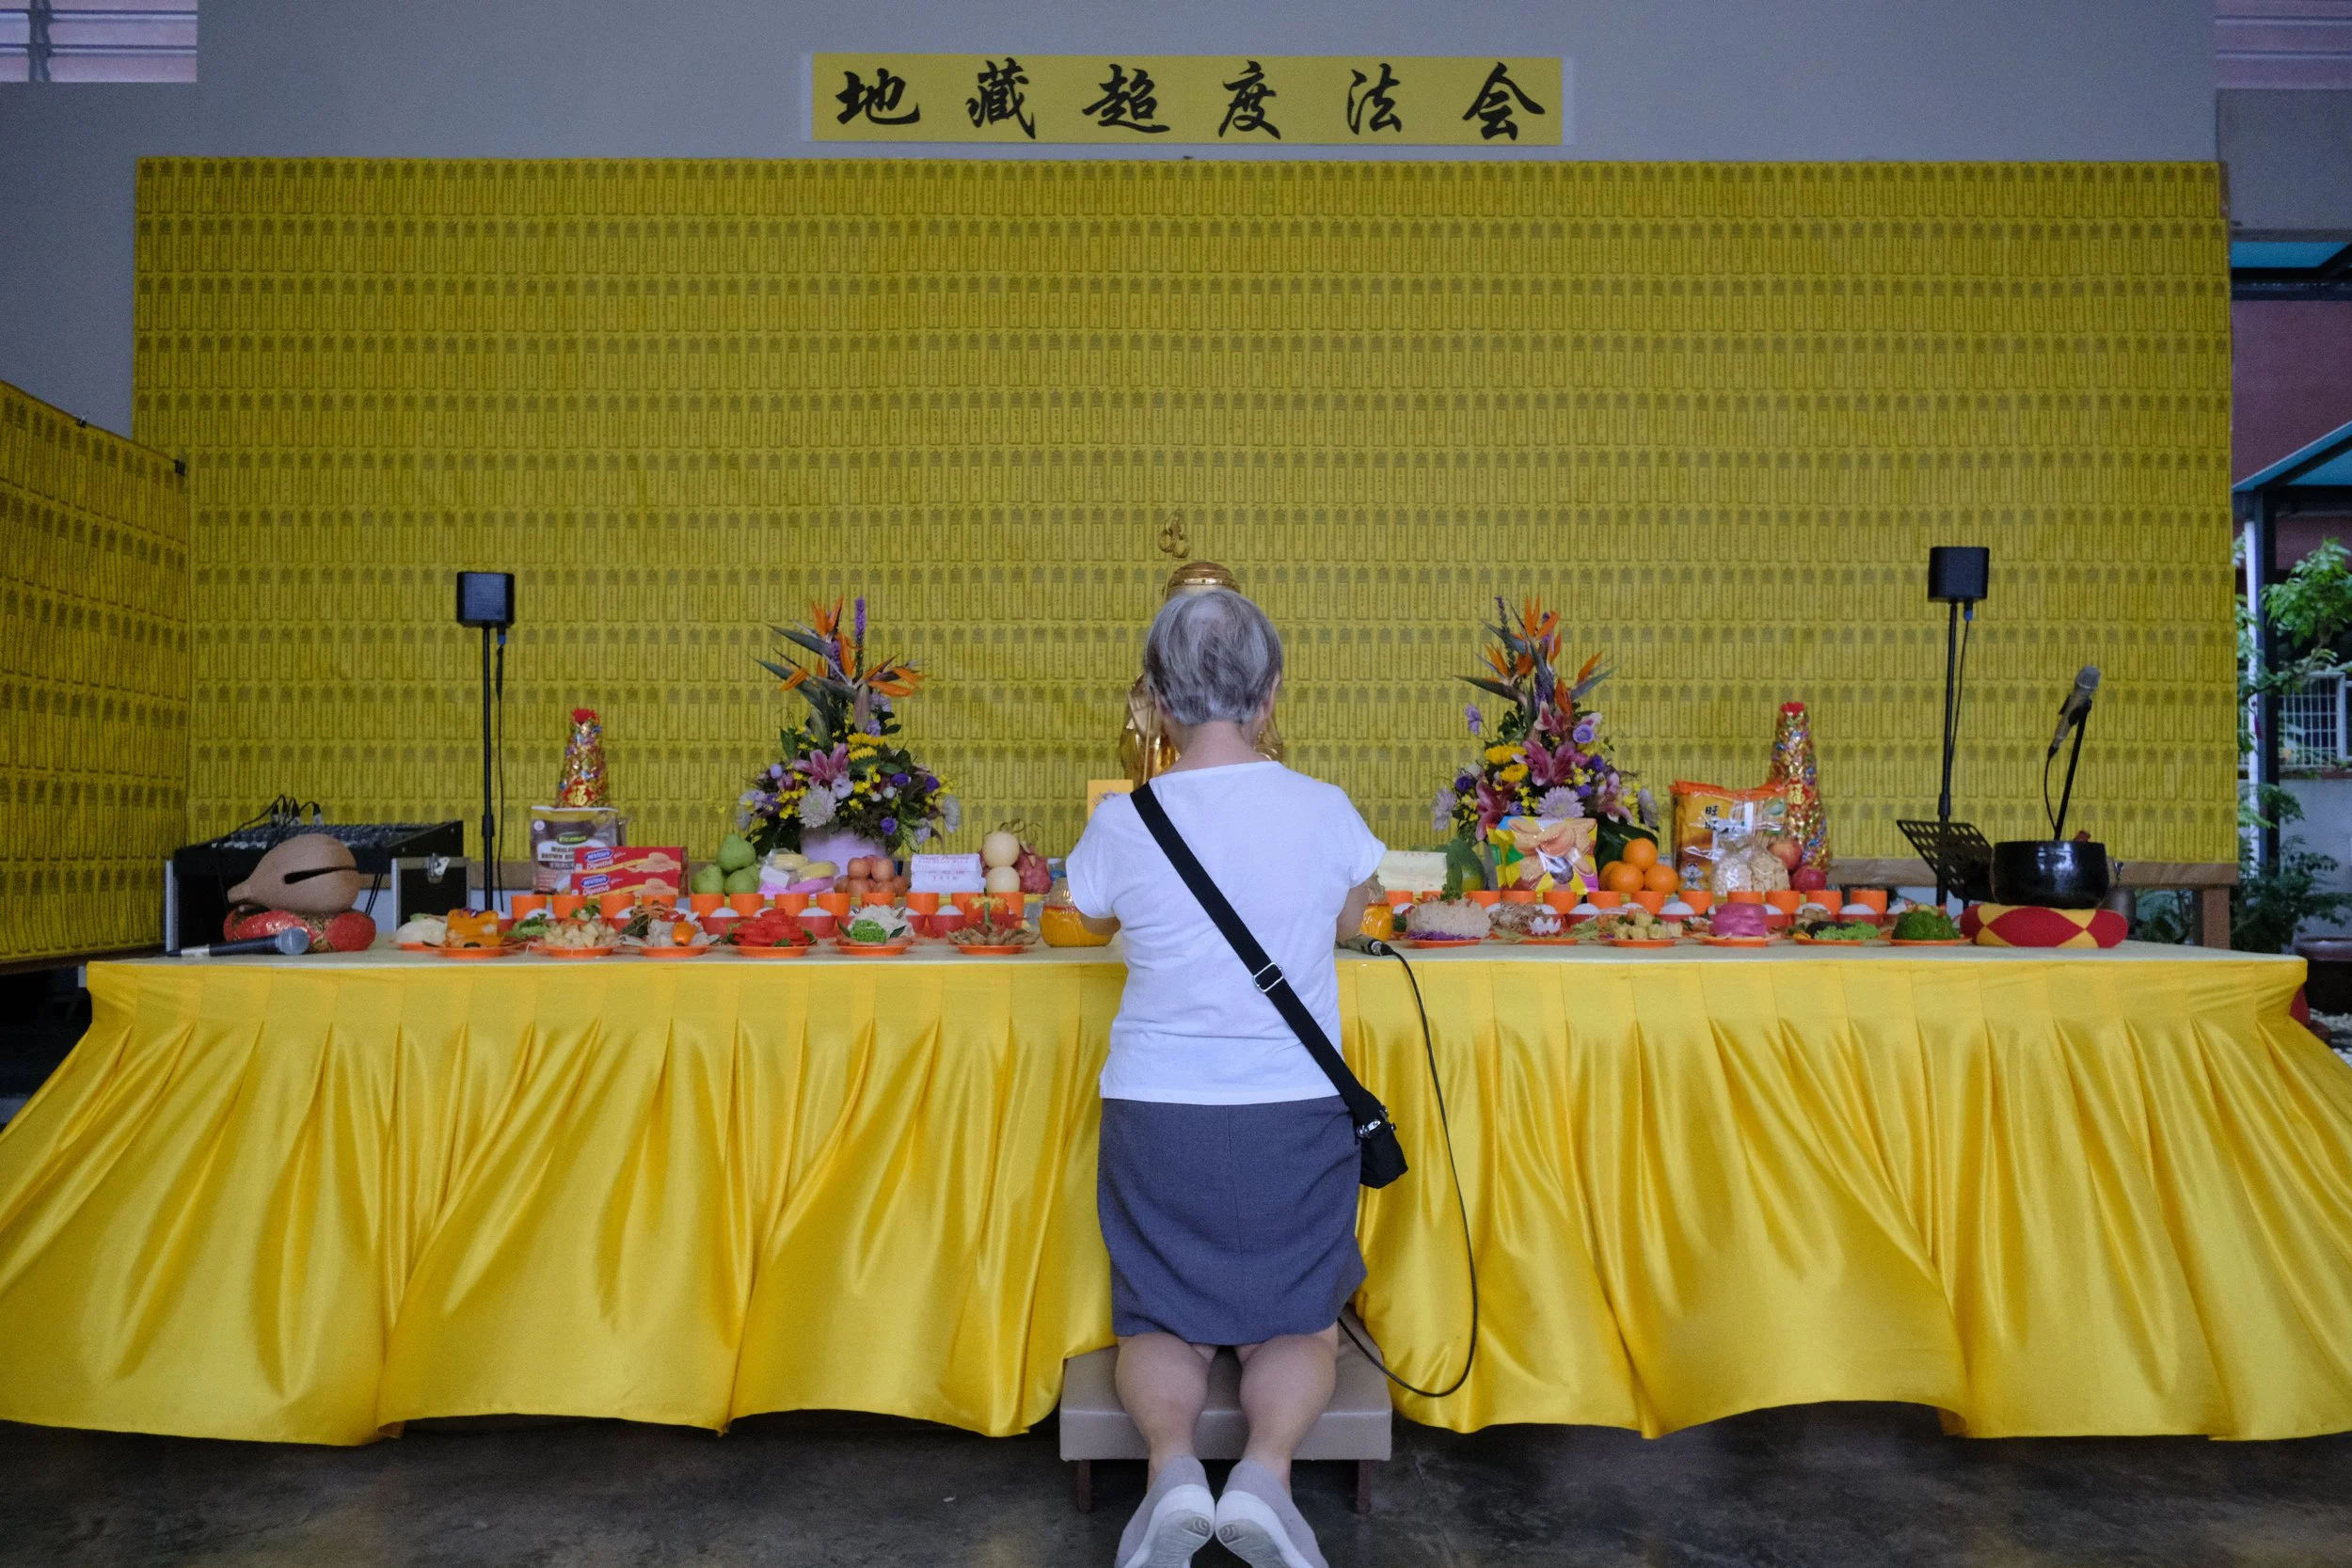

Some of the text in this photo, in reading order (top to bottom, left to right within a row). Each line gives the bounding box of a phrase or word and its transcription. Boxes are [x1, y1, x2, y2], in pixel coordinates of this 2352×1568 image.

[834, 57, 1547, 141] 地藏超度法会
